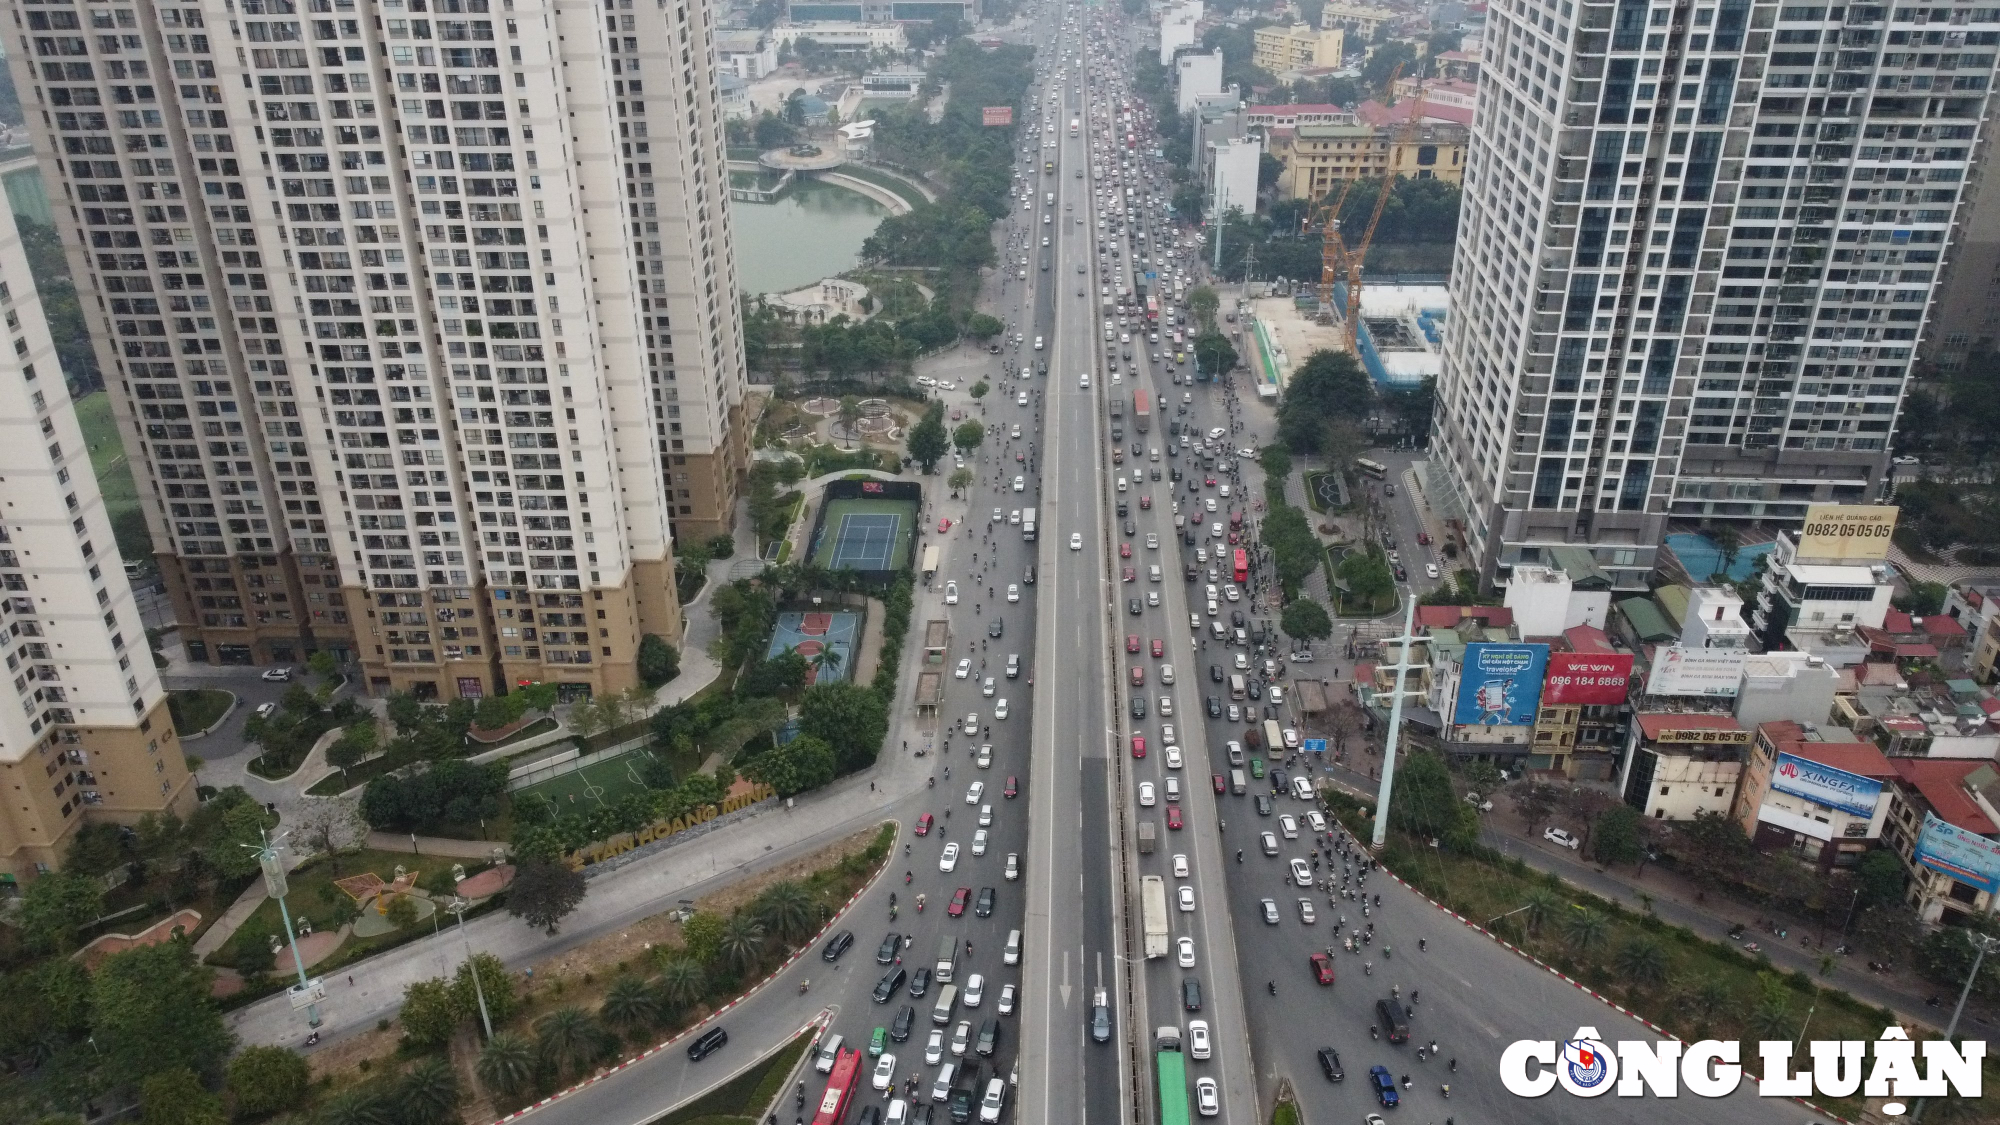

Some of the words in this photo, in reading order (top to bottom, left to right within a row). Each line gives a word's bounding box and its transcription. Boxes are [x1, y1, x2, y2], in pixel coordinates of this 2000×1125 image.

[1807, 523, 1838, 536] 0982
[1840, 524, 1855, 536] 05
[1857, 524, 1873, 537] 05
[1874, 525, 1890, 537] 05
[1551, 676, 1571, 685] 096
[1575, 677, 1594, 685] 184
[1598, 677, 1625, 686] 6868
[1675, 732, 1700, 740] 0982
[1718, 733, 1731, 741] 05
[1733, 733, 1747, 741] 05
[1802, 770, 1854, 792] XINGFA
[723, 784, 777, 814] MINH
[1936, 824, 1953, 835] SP
